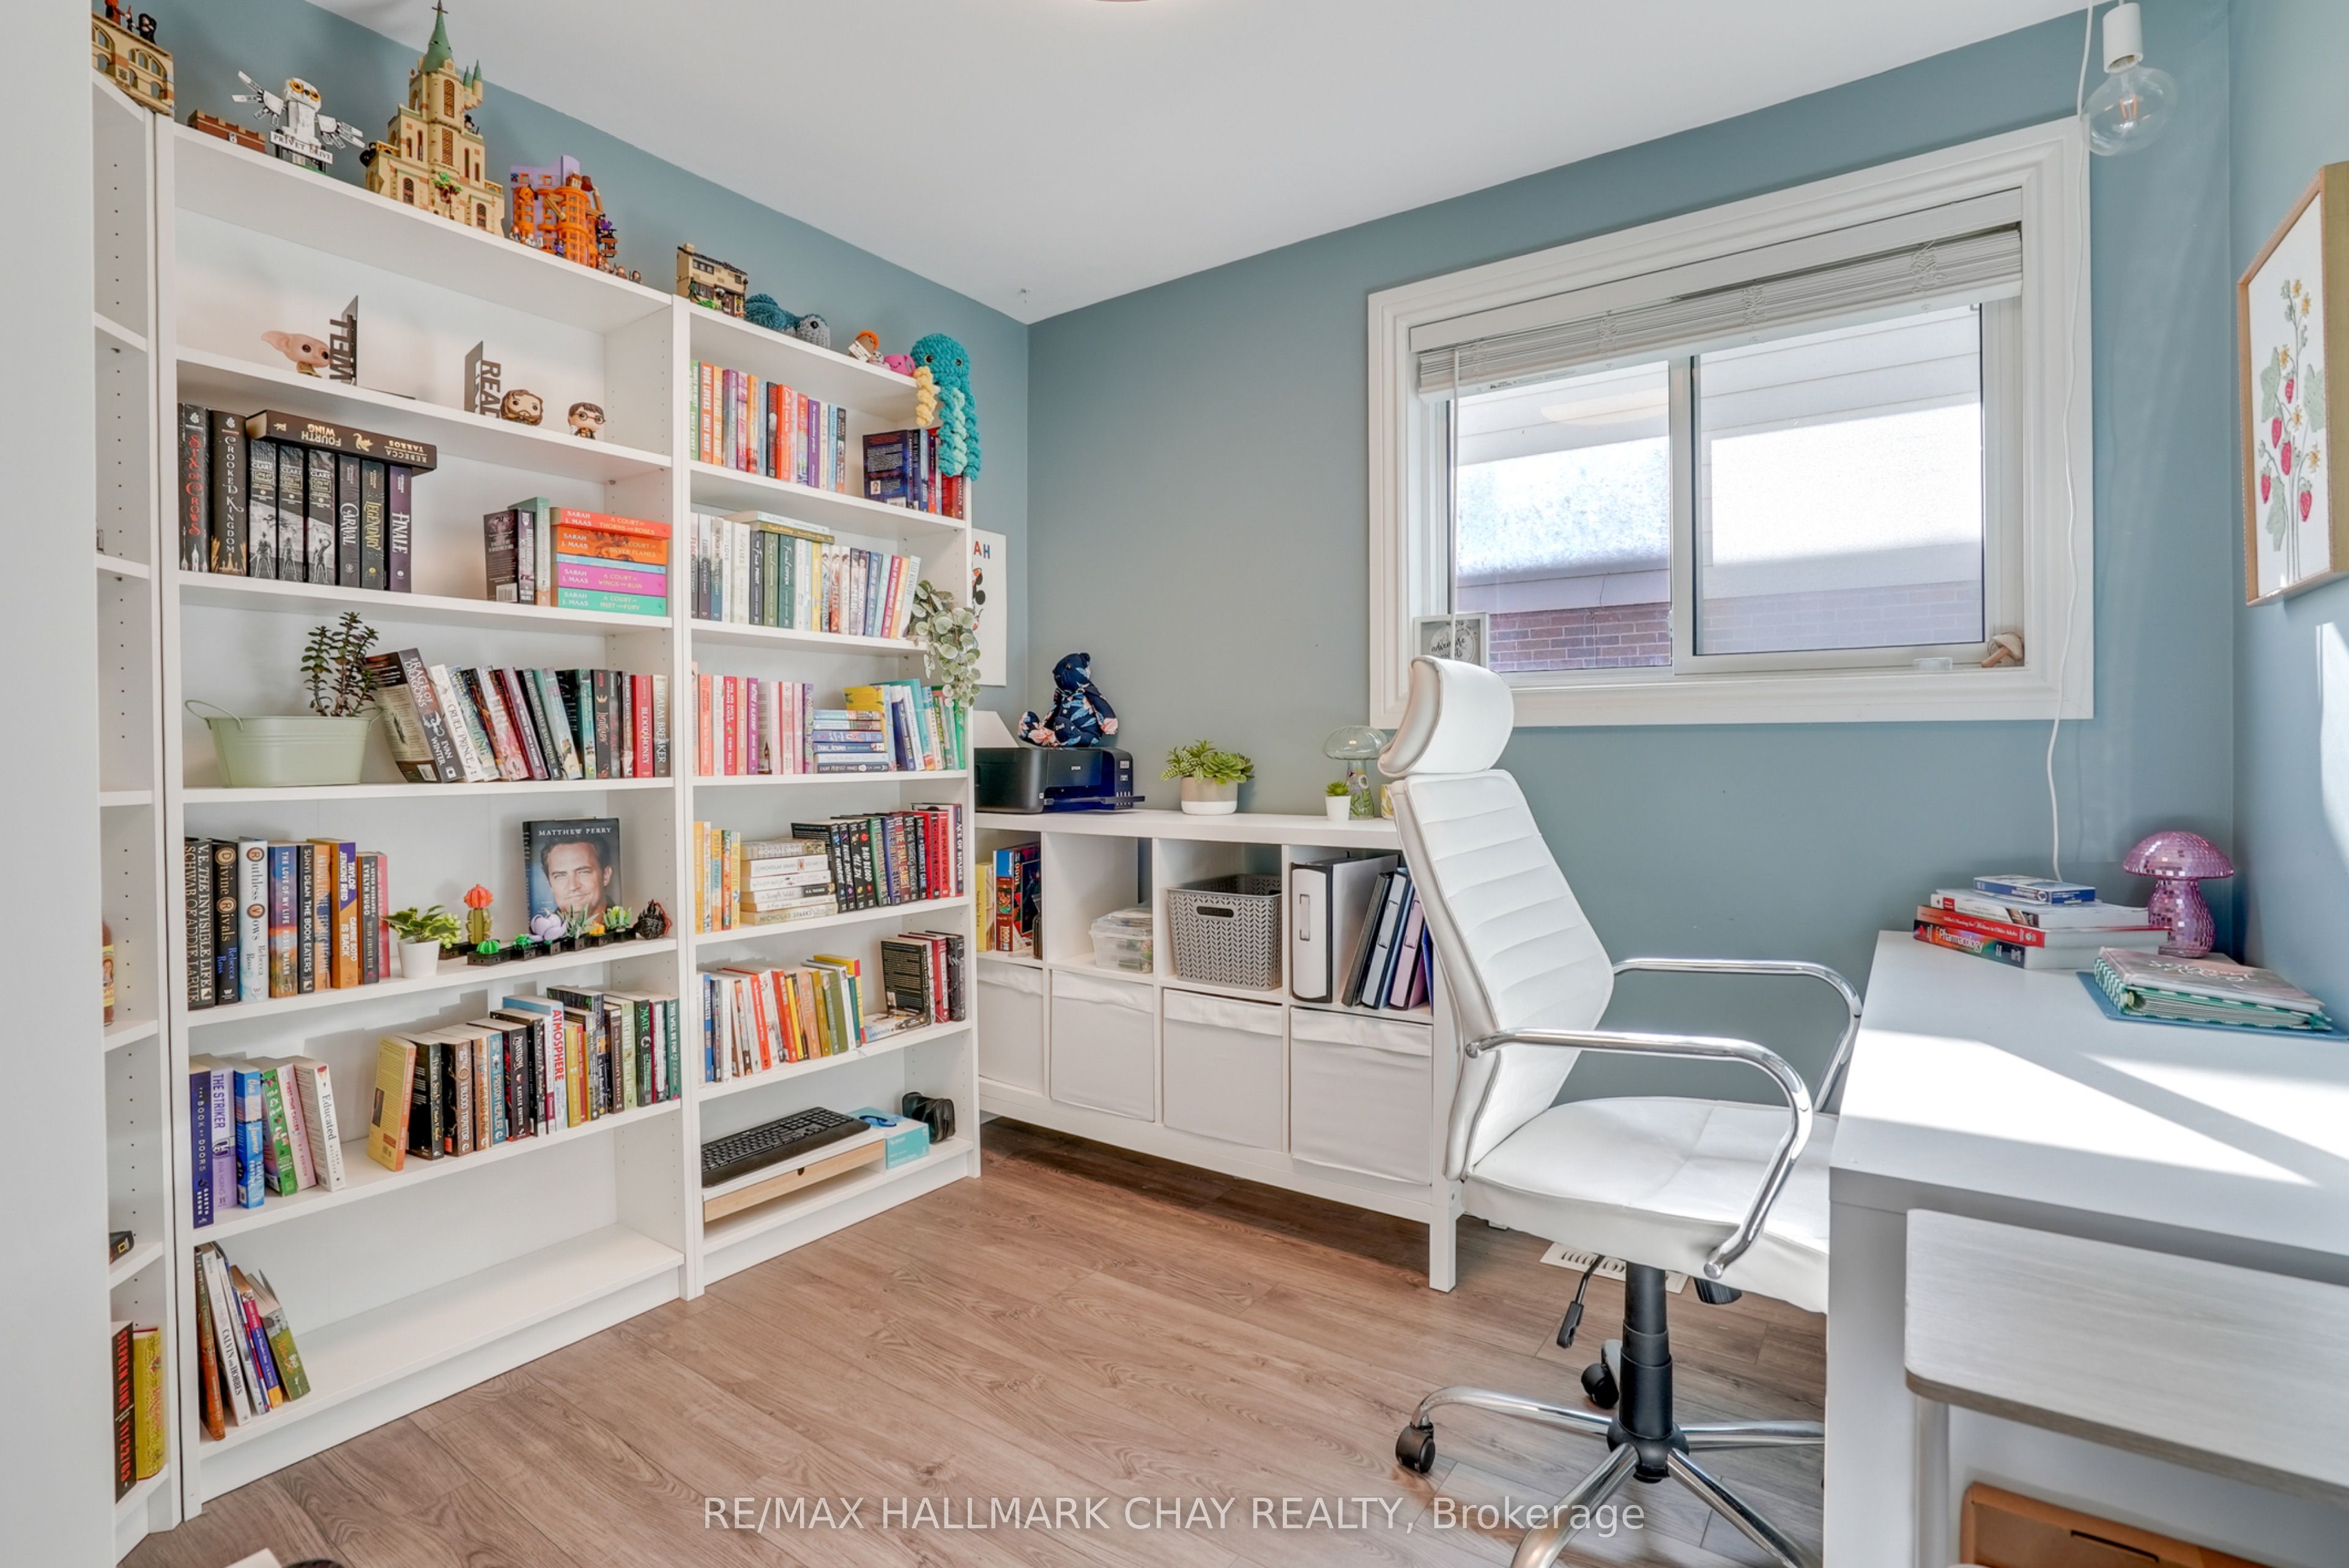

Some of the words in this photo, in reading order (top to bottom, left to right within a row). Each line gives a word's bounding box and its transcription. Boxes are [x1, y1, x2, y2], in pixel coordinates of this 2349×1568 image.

[274, 135, 306, 150] PRIVET
[309, 146, 332, 160] DRIVE
[330, 314, 353, 380] WELL
[301, 431, 341, 446] FOURTH
[307, 424, 335, 437] WING
[188, 435, 201, 469] SIX
[386, 449, 427, 464] REBECCA
[389, 440, 424, 453] YARROS
[223, 435, 239, 494] CROOKED
[186, 483, 203, 536] CROWS
[226, 496, 244, 553] KINGDOM
[365, 501, 381, 550] LEGENDARY
[392, 512, 410, 554] FINALE
[404, 661, 427, 708] DRAGONS
[412, 660, 430, 690] RAGE
[424, 691, 433, 704] OF
[441, 741, 453, 759] EVAN
[447, 704, 463, 733] CRUEL
[459, 734, 475, 767] PRINCE
[656, 722, 666, 763] BREAKER
[431, 737, 446, 766] WINTER
[198, 844, 209, 854] V.
[957, 839, 963, 850] OF
[185, 846, 197, 896] SCHWAB
[199, 856, 210, 866] E.
[215, 848, 236, 895] Divine
[247, 847, 265, 900] Ruthless
[317, 855, 328, 883] ANXIOUS
[198, 868, 210, 892] THE
[282, 886, 289, 895] OF
[899, 867, 909, 889] GAMBIT
[185, 899, 196, 918] OF
[282, 897, 289, 907] MY
[316, 886, 328, 908] PEOPLE
[199, 895, 210, 957] INVISIBLE
[216, 897, 237, 942] Rivals
[247, 903, 265, 941] Vows
[759, 912, 791, 923] NICHOLAS
[793, 908, 812, 917] SPARKS
[187, 920, 196, 957] ADDIE
[1939, 929, 1984, 954] Pharmacology
[201, 959, 211, 987] LIFE
[217, 956, 226, 974] Ross
[228, 947, 237, 980] Rebecca
[246, 953, 255, 971] Ross
[257, 945, 265, 976] Rebecca
[187, 961, 197, 1003] LARUE
[640, 1005, 650, 1031] MATE
[552, 1009, 565, 1081] ATMOSPHERE
[213, 1074, 224, 1090] THE
[431, 1057, 440, 1081] Poison
[431, 1082, 440, 1100] Study
[459, 1086, 468, 1109] BLOOD
[494, 1076, 502, 1101] PRISON
[213, 1092, 225, 1129] STRIKER
[322, 1093, 336, 1141] Educated
[494, 1103, 503, 1130] HEALER
[460, 1112, 469, 1141] TRAITOR
[117, 1331, 128, 1378] STEPHEN
[222, 1328, 236, 1360] CALVIN
[230, 1365, 243, 1397] HOBBES
[119, 1380, 129, 1410] KING
